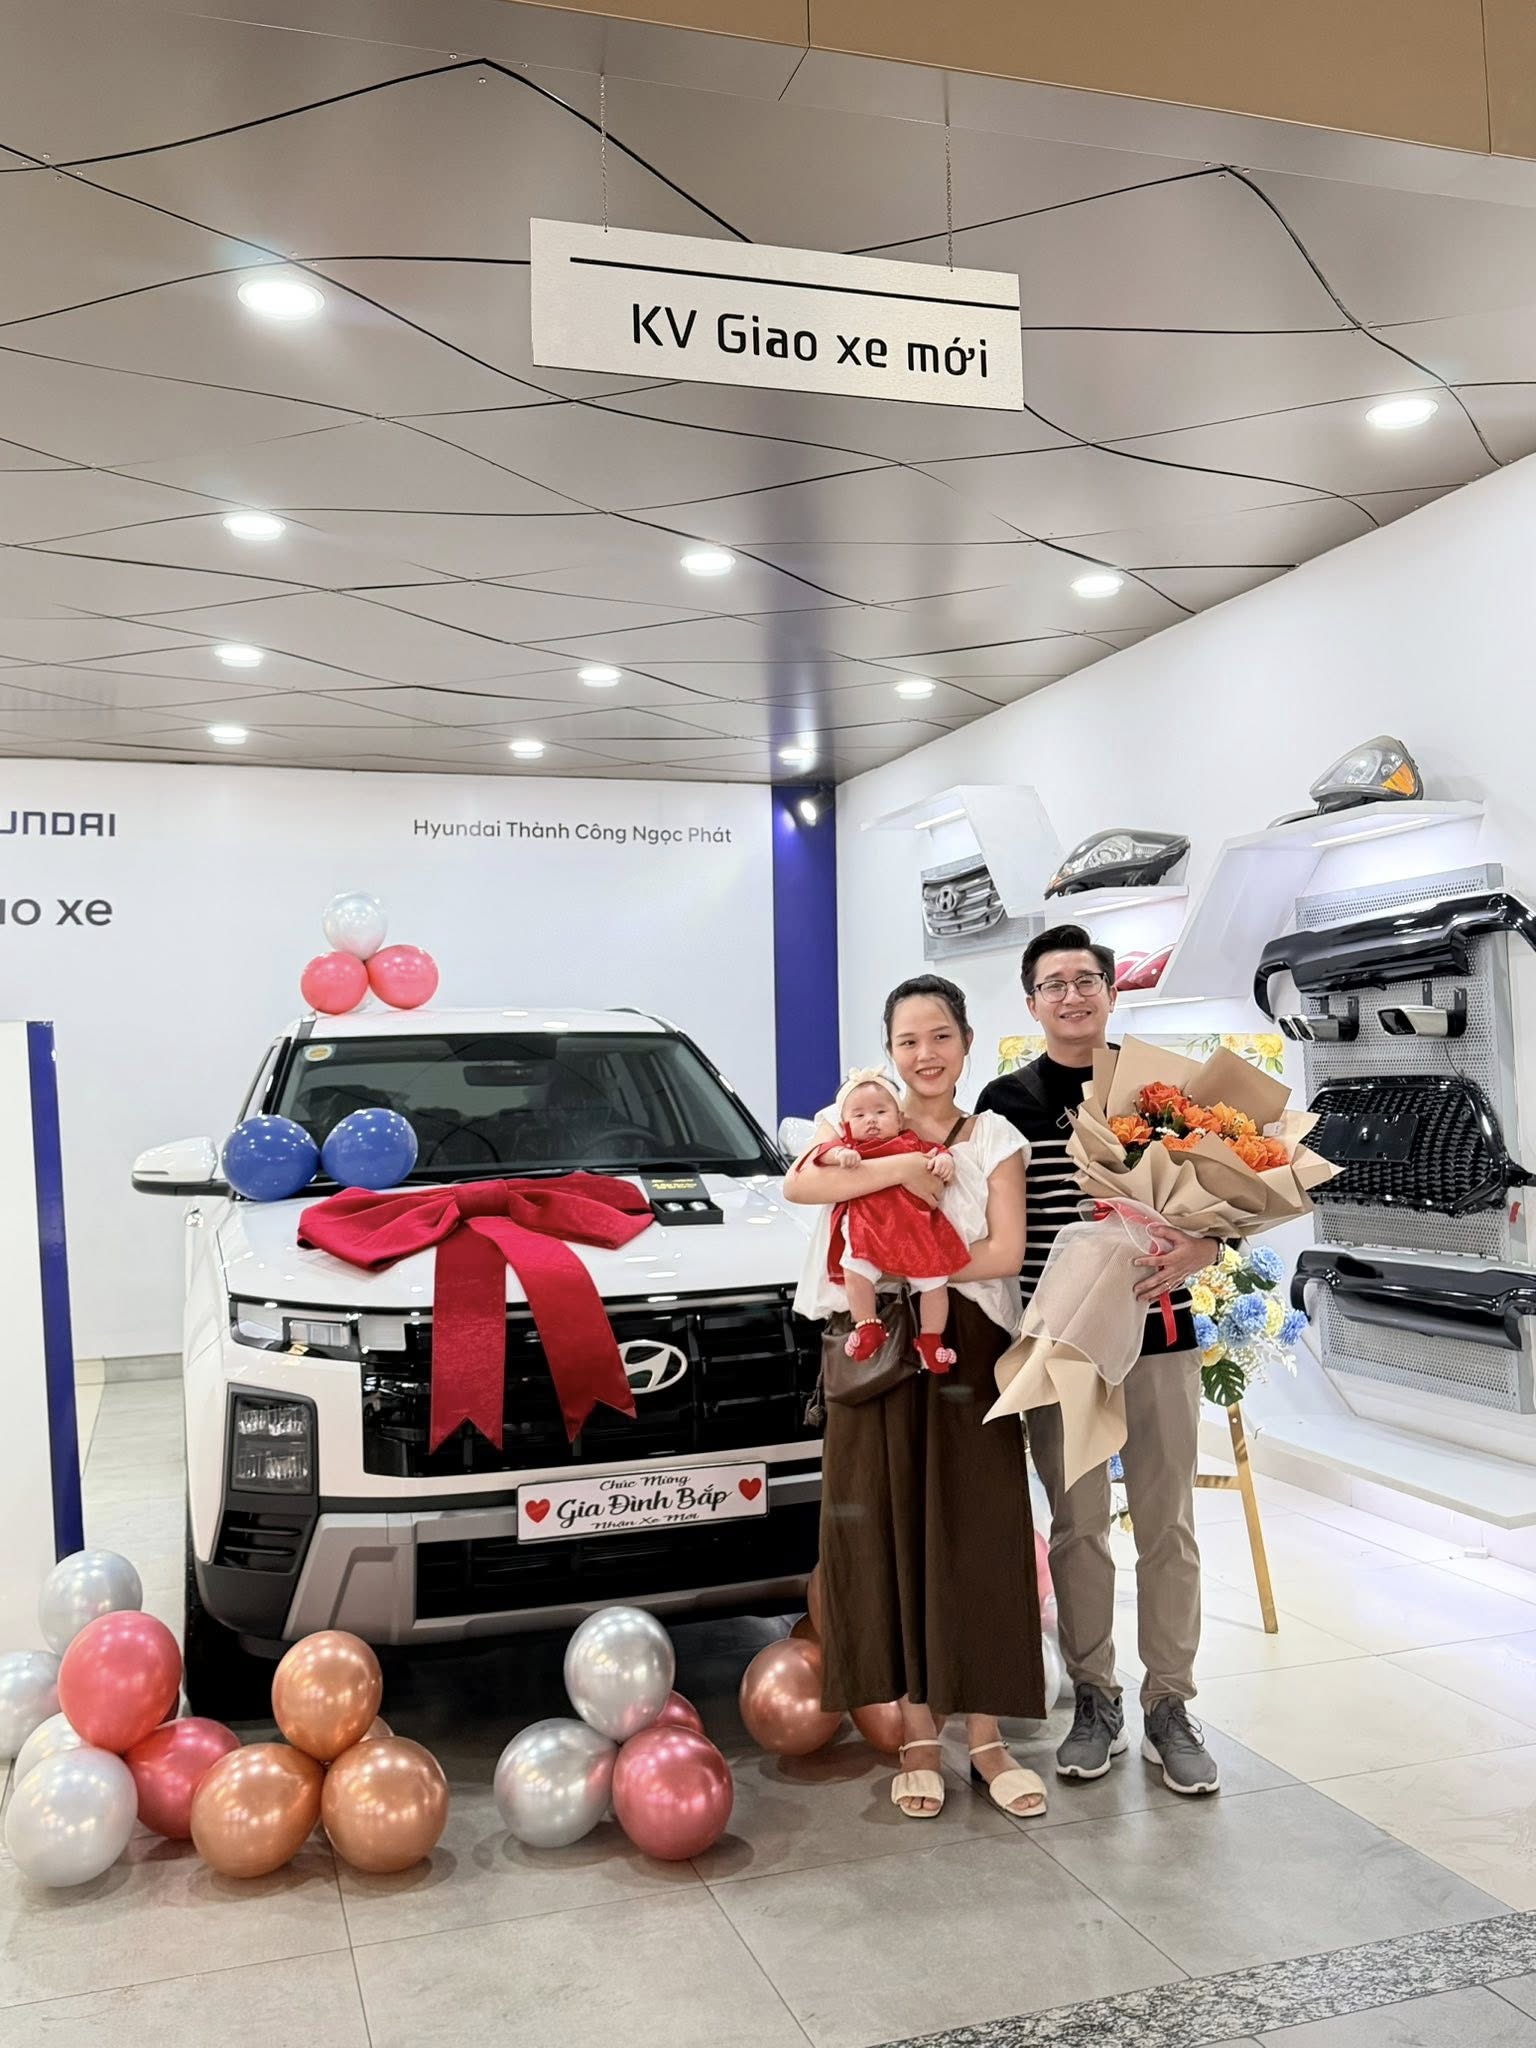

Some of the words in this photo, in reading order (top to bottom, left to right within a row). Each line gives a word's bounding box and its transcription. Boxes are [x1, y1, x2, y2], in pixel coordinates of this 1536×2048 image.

[632, 303, 697, 349] KV
[716, 313, 818, 362] Giao
[836, 334, 888, 368] xe
[907, 336, 987, 378] mới
[413, 818, 501, 840] Hyundai
[505, 820, 570, 840] Thành
[575, 823, 627, 844] Công
[632, 825, 683, 845] Ngọc
[688, 826, 732, 844] Phát
[0, 898, 42, 926] o
[55, 899, 113, 926] xe
[556, 1498, 605, 1529] Gia
[608, 1490, 674, 1516] Đình
[676, 1484, 733, 1512] Bắp
